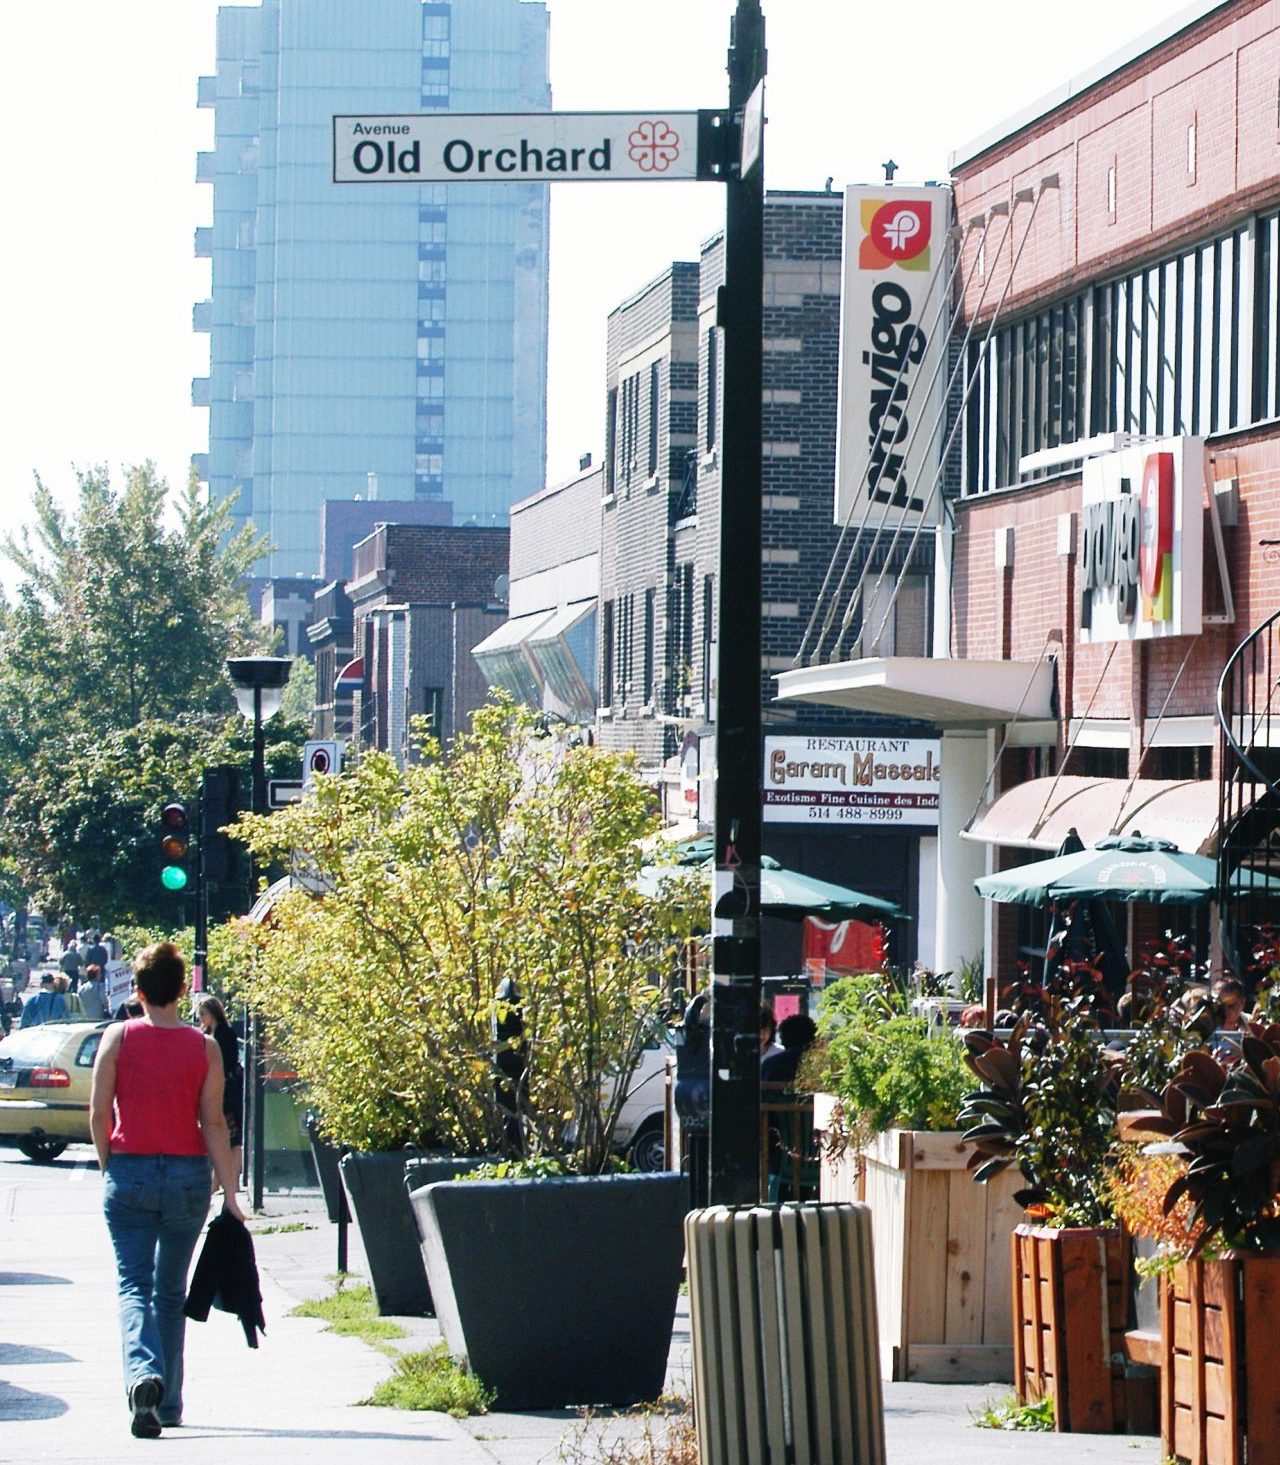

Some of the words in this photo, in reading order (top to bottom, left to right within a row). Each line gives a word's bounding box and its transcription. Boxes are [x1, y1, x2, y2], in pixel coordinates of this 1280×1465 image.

[352, 122, 411, 136] Avenue
[352, 140, 421, 174] Old
[443, 138, 612, 173] Orchard
[862, 281, 926, 512] provigo
[806, 738, 910, 753] RESTAURANT
[770, 749, 847, 786] Garam
[766, 791, 816, 803] Exotisme
[821, 793, 845, 804] Fine
[849, 794, 891, 805] Cuisine
[894, 795, 912, 806] des
[808, 807, 830, 818] 514
[836, 807, 903, 820] 488-8999
